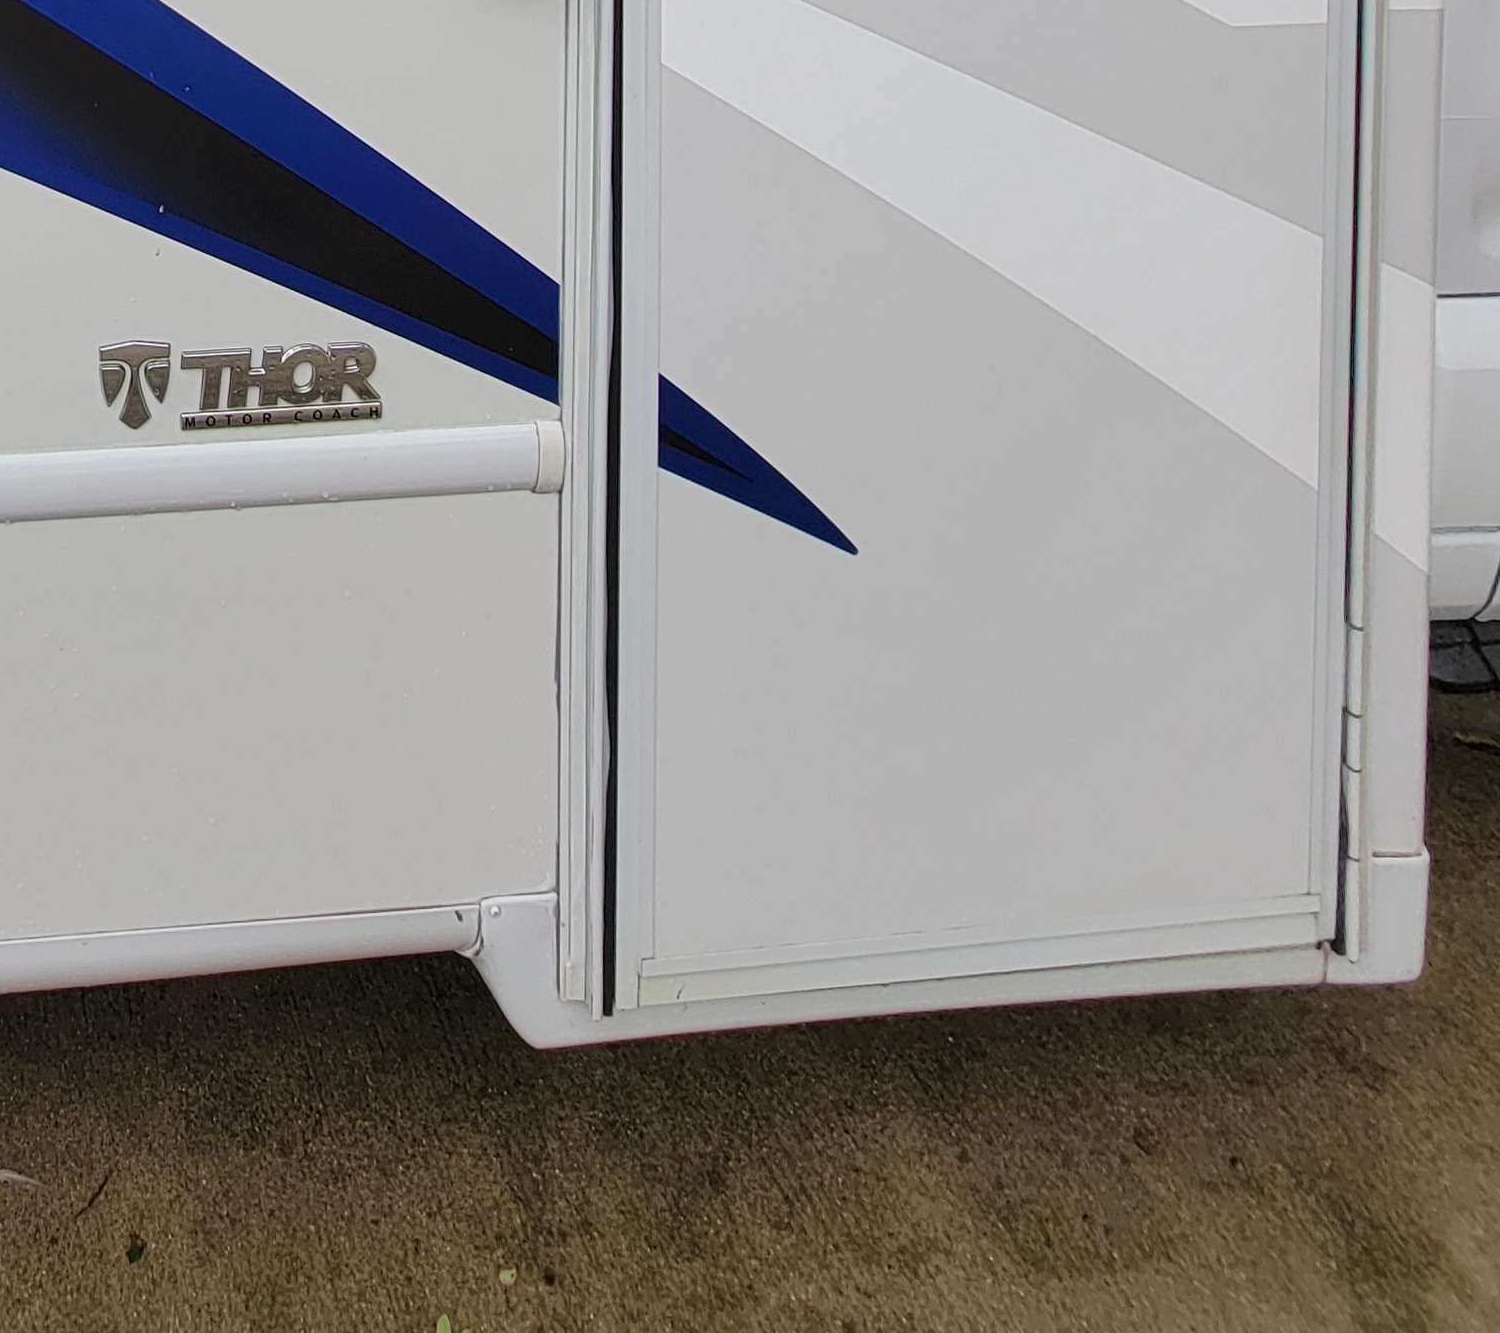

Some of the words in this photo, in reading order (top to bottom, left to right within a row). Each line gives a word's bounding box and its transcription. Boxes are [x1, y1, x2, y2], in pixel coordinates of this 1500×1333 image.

[180, 341, 381, 411] THOR
[183, 411, 273, 429] MOTOR
[294, 405, 380, 423] COACH
